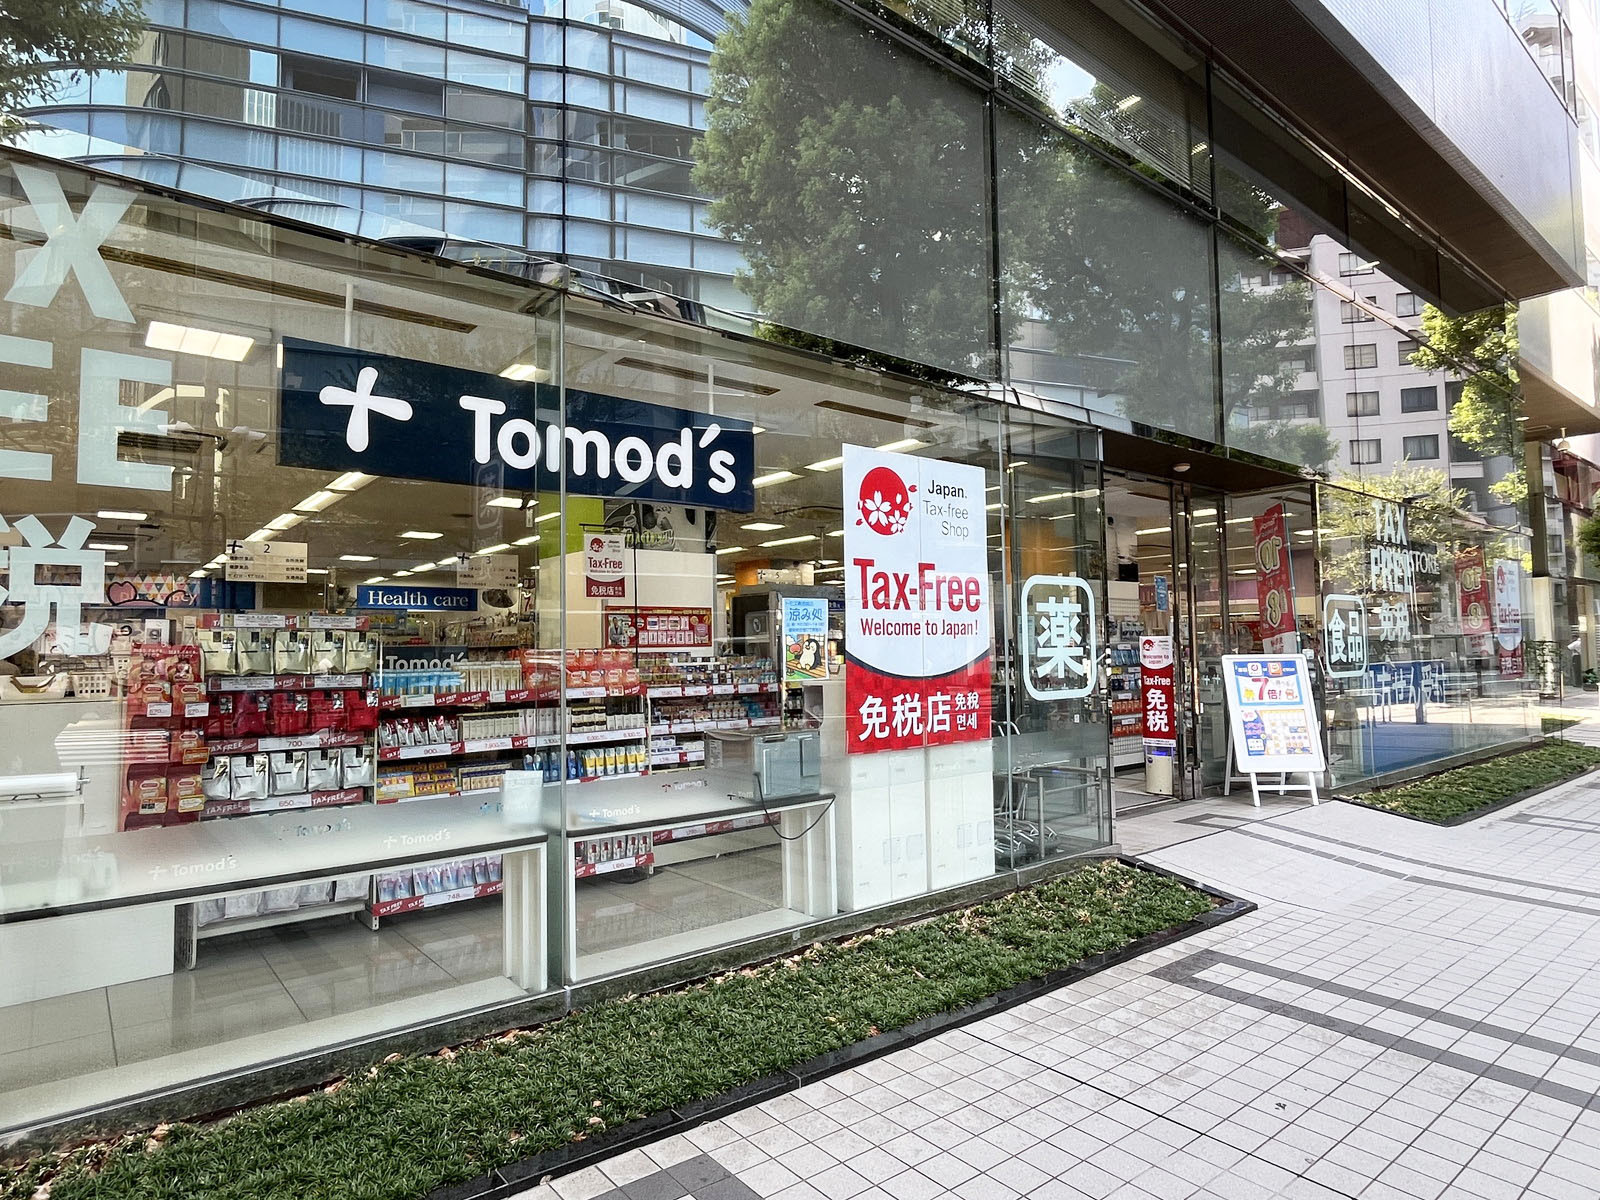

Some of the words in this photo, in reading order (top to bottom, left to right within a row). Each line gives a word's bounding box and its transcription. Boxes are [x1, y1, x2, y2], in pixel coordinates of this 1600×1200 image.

[459, 395, 736, 495] Tomod's
[923, 499, 969, 520] Tax-free
[941, 520, 970, 541] Shop
[264, 544, 270, 554] 2
[485, 556, 491, 564] 3
[587, 557, 623, 569] Tax-Free
[591, 585, 614, 596] 免税店
[852, 557, 981, 613] Tax-Free
[368, 590, 427, 606] Health
[433, 594, 469, 607] care
[860, 618, 921, 636] Welcome
[925, 619, 938, 636] to
[941, 618, 979, 639] Japan!
[1036, 596, 1085, 679] 薬
[1328, 609, 1363, 663] 食品
[386, 652, 470, 670] Tomod'
[1143, 675, 1171, 686] Tax-Free
[858, 691, 951, 741] 免税店
[1146, 688, 1170, 733] 免税
[956, 712, 978, 731] 면세
[222, 740, 243, 752] FREE
[279, 799, 293, 807] 650
[312, 797, 327, 805] TAX
[327, 792, 345, 803] FREE
[207, 805, 223, 814] TAX
[602, 804, 640, 819] Tomod's
[401, 828, 451, 847] Tomod's
[170, 854, 237, 877] Tomod's
